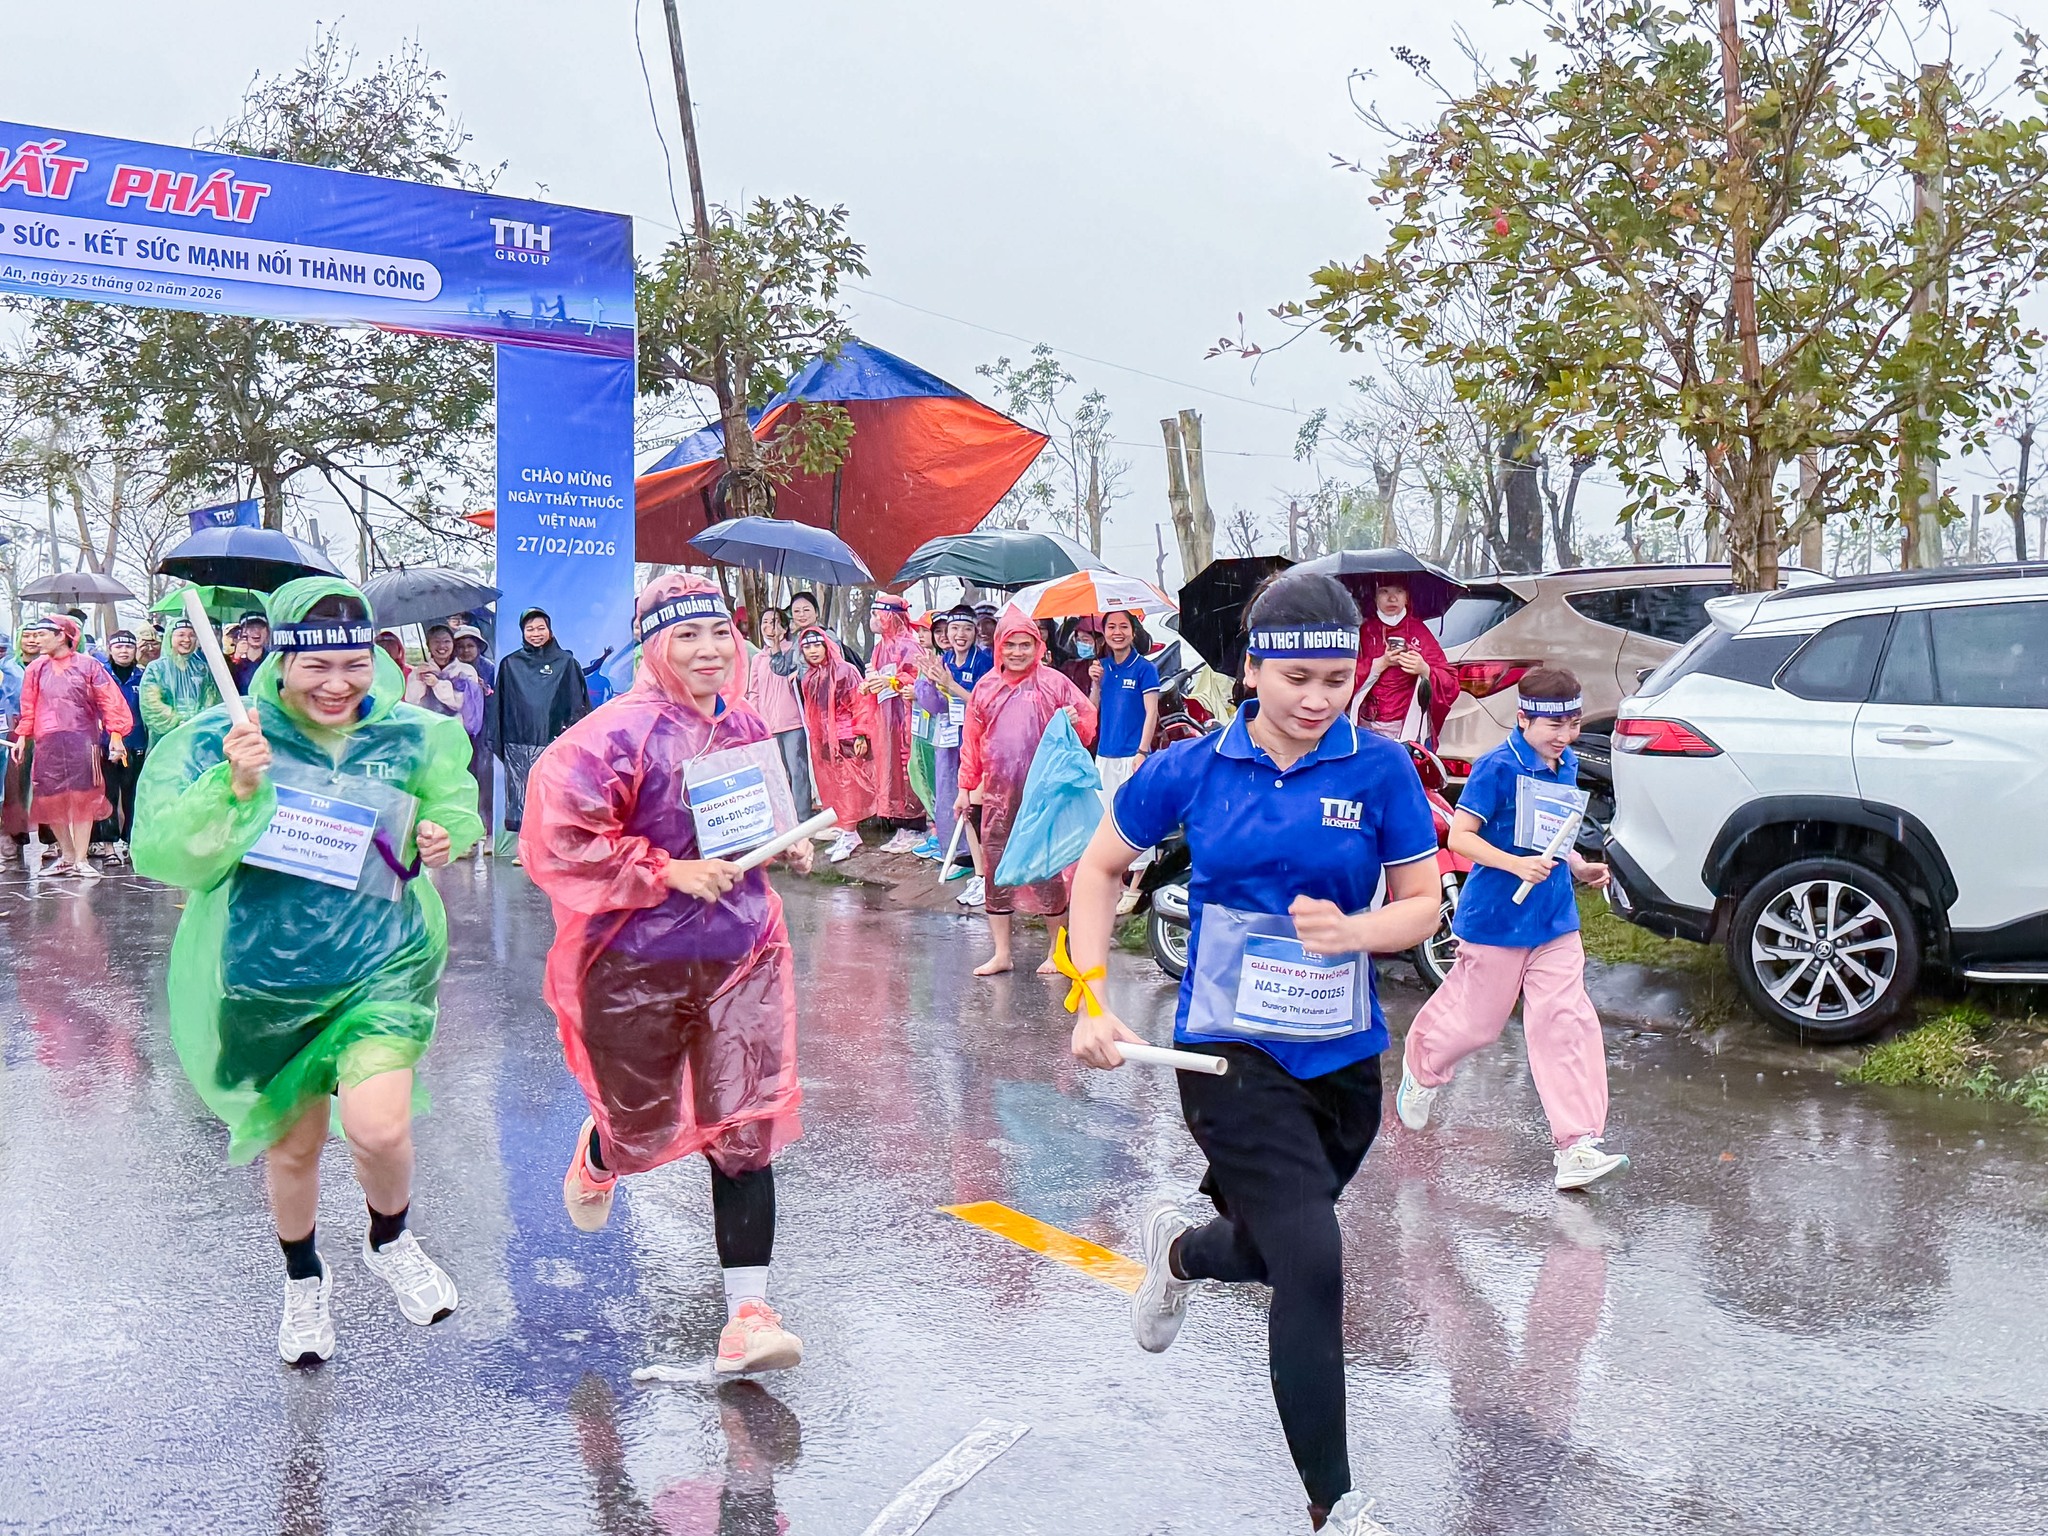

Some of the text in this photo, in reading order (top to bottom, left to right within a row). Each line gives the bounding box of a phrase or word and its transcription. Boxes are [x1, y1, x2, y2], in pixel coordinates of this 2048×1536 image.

[0, 138, 271, 224] ẤT PHÁT
[490, 217, 550, 251] TTH
[13, 221, 60, 248] SỨC
[84, 228, 128, 256] KẾT
[136, 236, 180, 262] SỨC
[188, 245, 249, 271] MẠNH
[257, 249, 292, 276] NỐI
[299, 257, 366, 284] THÀNH
[373, 264, 425, 291] CÔNG
[495, 249, 550, 265] GROUP
[3, 265, 222, 300] An, ngày 25 tháng 02 năm 2026
[521, 467, 613, 488] CHÀO MỪNG
[508, 490, 542, 504] NGÀY
[580, 495, 624, 510] THUỐC
[538, 513, 596, 529] VIỆT NAM
[516, 536, 616, 557] 27/02/2026
[659, 604, 676, 622] TTH
[676, 596, 713, 616] QUẢNG
[297, 629, 322, 645] TTH
[326, 626, 347, 644] HÀ
[1271, 632, 1300, 649] YHCT
[310, 797, 331, 809] TTH
[1320, 797, 1363, 821] TTH
[1322, 817, 1362, 830] HOSPITAL
